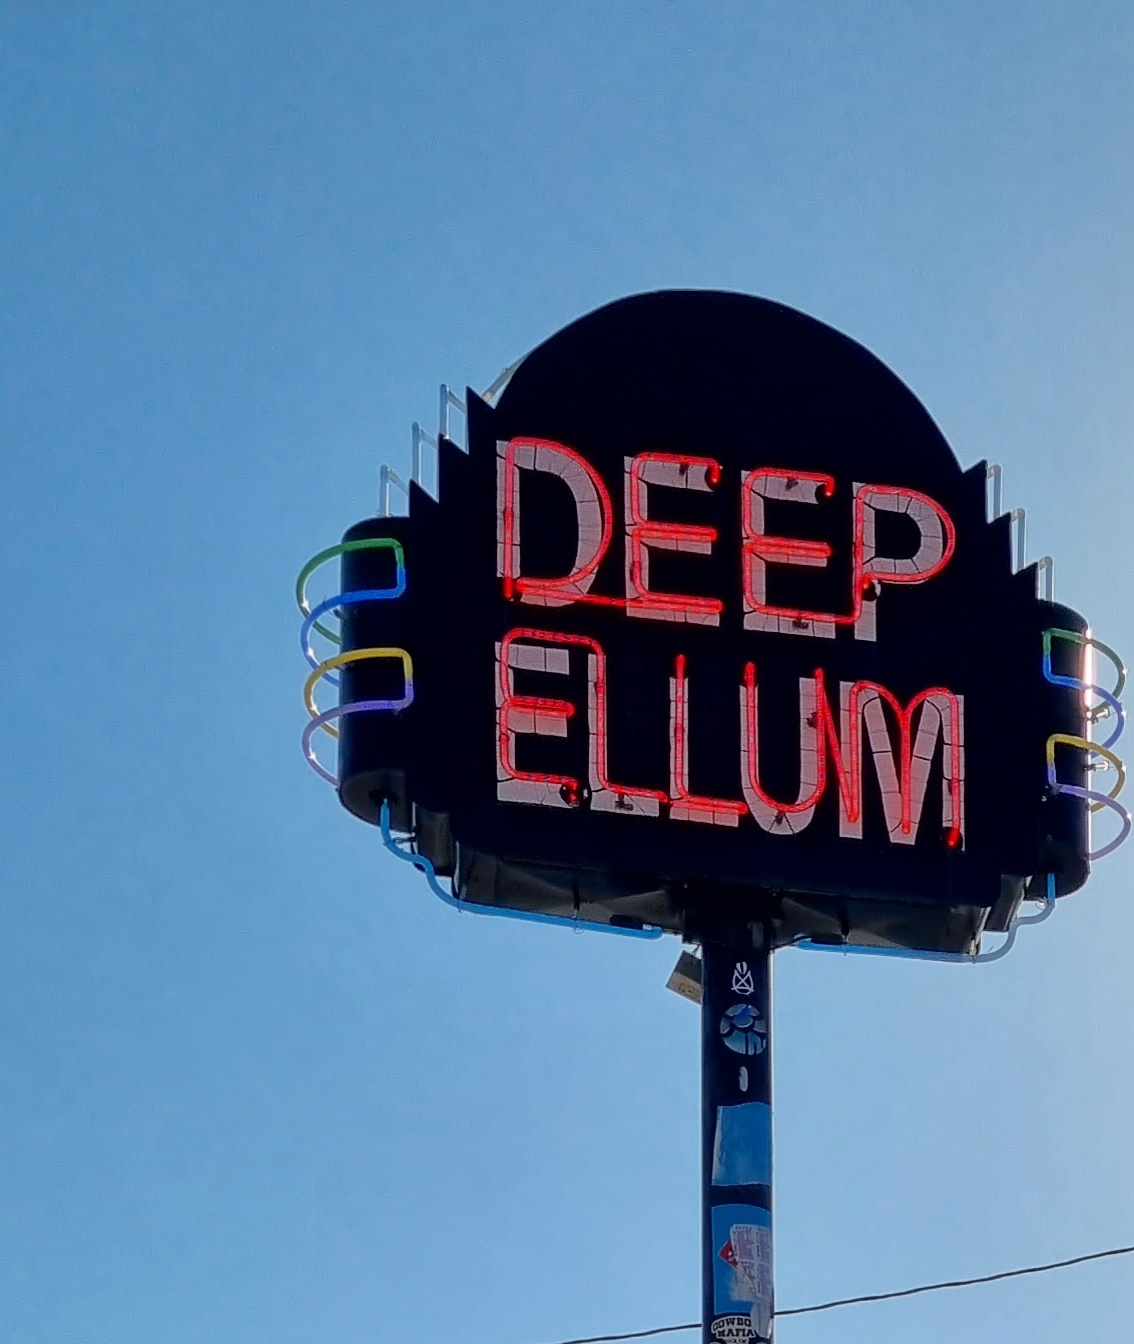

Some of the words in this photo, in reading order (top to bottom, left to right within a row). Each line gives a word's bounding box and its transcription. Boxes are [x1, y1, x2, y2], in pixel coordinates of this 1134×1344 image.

[496, 437, 956, 642] DEEP
[494, 627, 966, 852] ELLUM
[712, 1316, 751, 1331] COWBO
[717, 1327, 755, 1338] MAFIA
